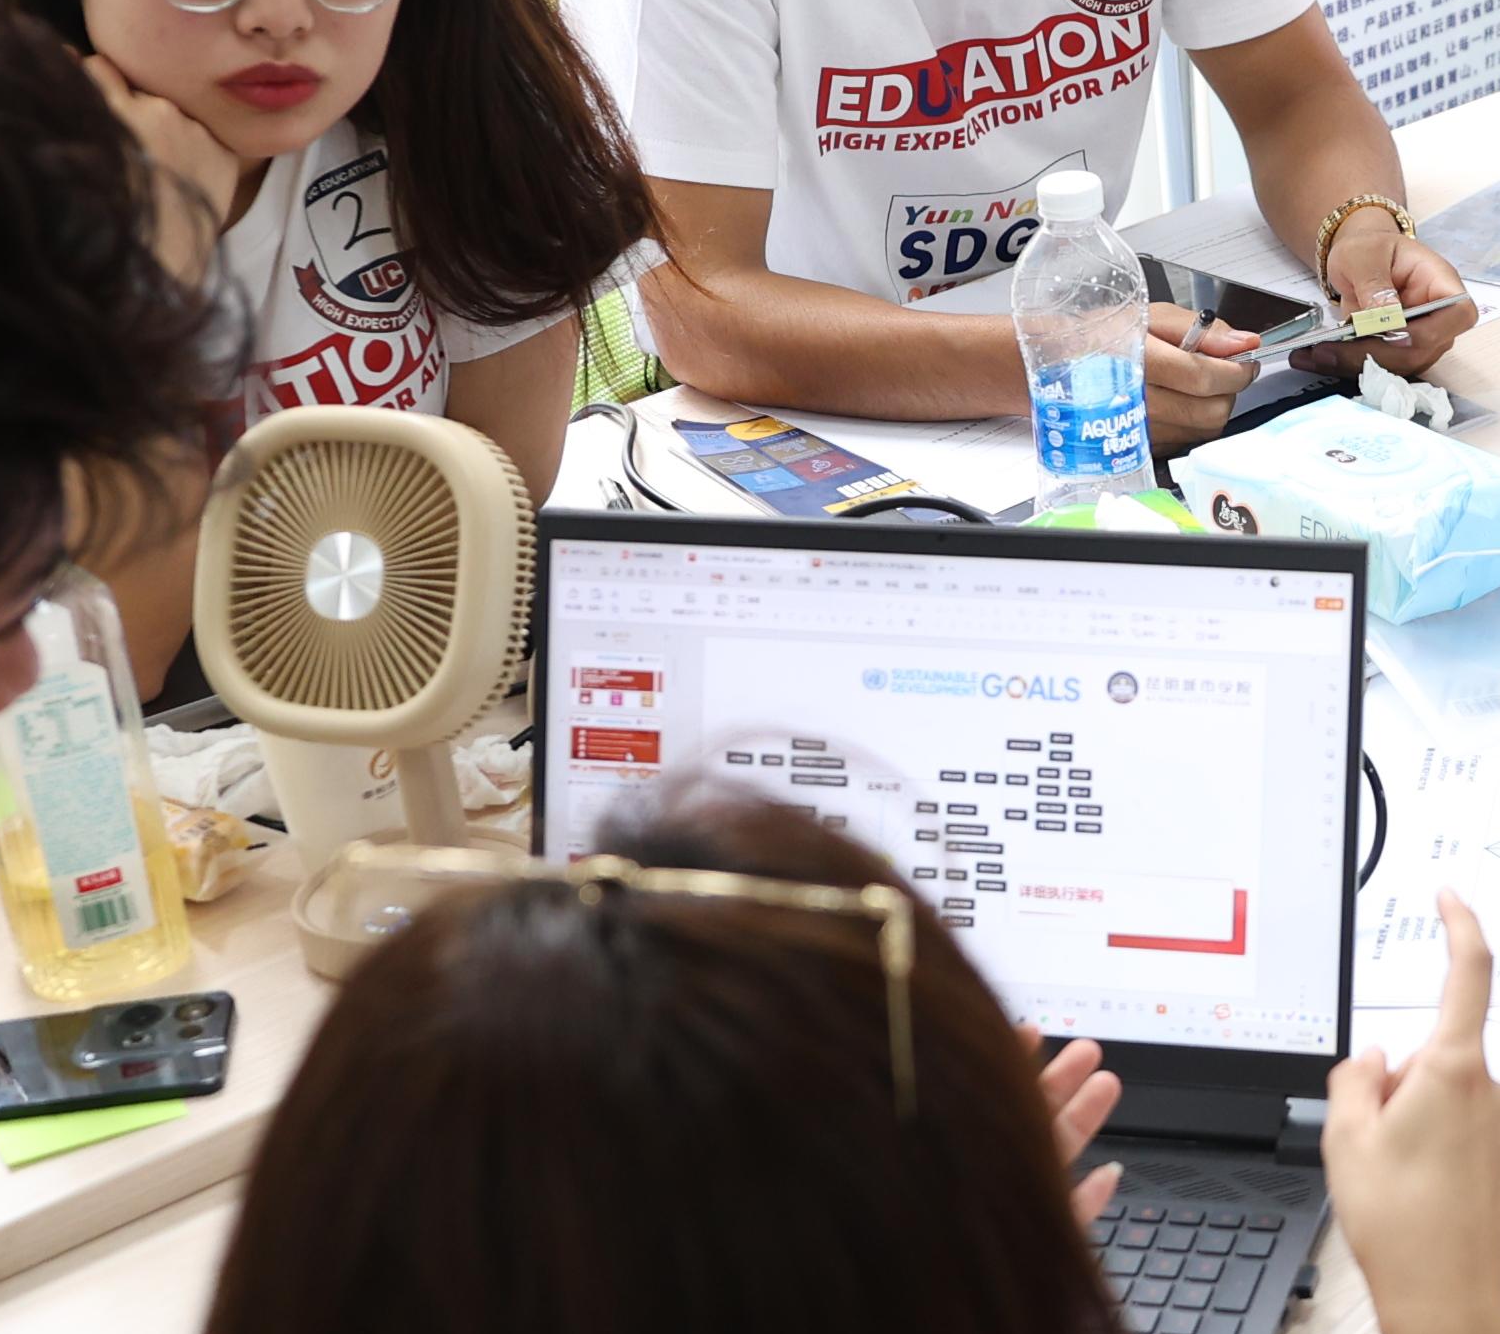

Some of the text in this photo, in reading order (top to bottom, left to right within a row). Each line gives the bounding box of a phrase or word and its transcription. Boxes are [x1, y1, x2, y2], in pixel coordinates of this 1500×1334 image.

[826, 15, 1145, 122] EDUATION
[818, 55, 1150, 157] HIGH EXPECATION FOR ALL
[317, 156, 381, 192] EDUCATION
[332, 190, 392, 250] 2
[905, 198, 1040, 226] Yun Na
[359, 260, 406, 297] UC
[312, 289, 422, 330] HIGH EXPECTATION
[245, 312, 433, 412] ATION
[891, 668, 978, 685] SUSTAINABLE
[891, 682, 977, 697] DEVELOPMENT
[981, 672, 1081, 703] GOALS
